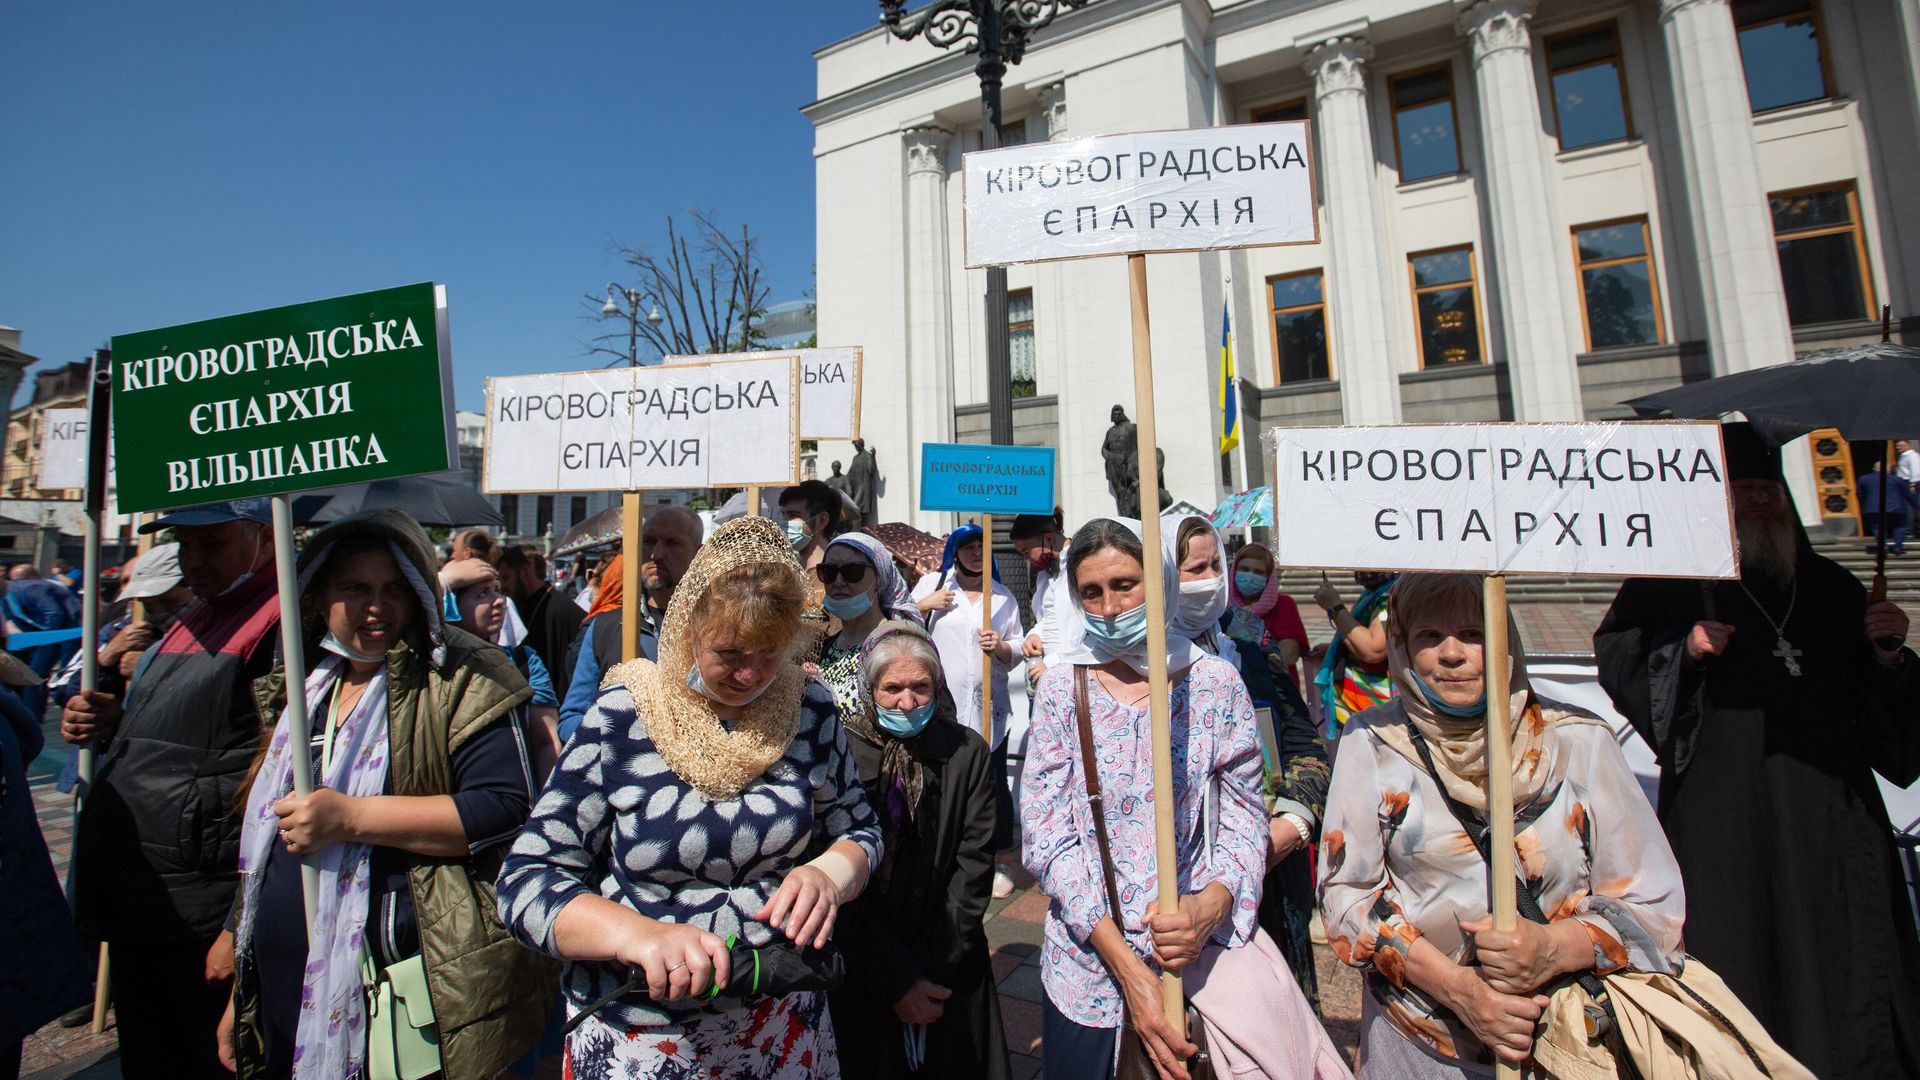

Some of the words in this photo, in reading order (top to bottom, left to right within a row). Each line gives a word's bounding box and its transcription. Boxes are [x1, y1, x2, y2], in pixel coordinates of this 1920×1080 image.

[985, 142, 1306, 194] КІРОВОГРАДСЬКА
[1043, 196, 1254, 236] ЄПАРХІЯ
[121, 316, 423, 392] КІРОВОГРАДСЬКА
[800, 362, 845, 384] ЬКА
[189, 381, 353, 434] ЄПАРХІЯ
[499, 380, 779, 421] КІРОВОГРАДСЬКА
[166, 432, 388, 492] ВІЛЬШАНКА
[562, 439, 700, 470] ЄПАРХІЯ
[930, 461, 1045, 477] КІРОВОГРАДСЬКА
[1302, 447, 1721, 490] КІРОВОГРАДСЬКА
[957, 482, 1017, 496] ЄПАРХІЯ
[1374, 508, 1653, 548] ЄПАРХІЯ
